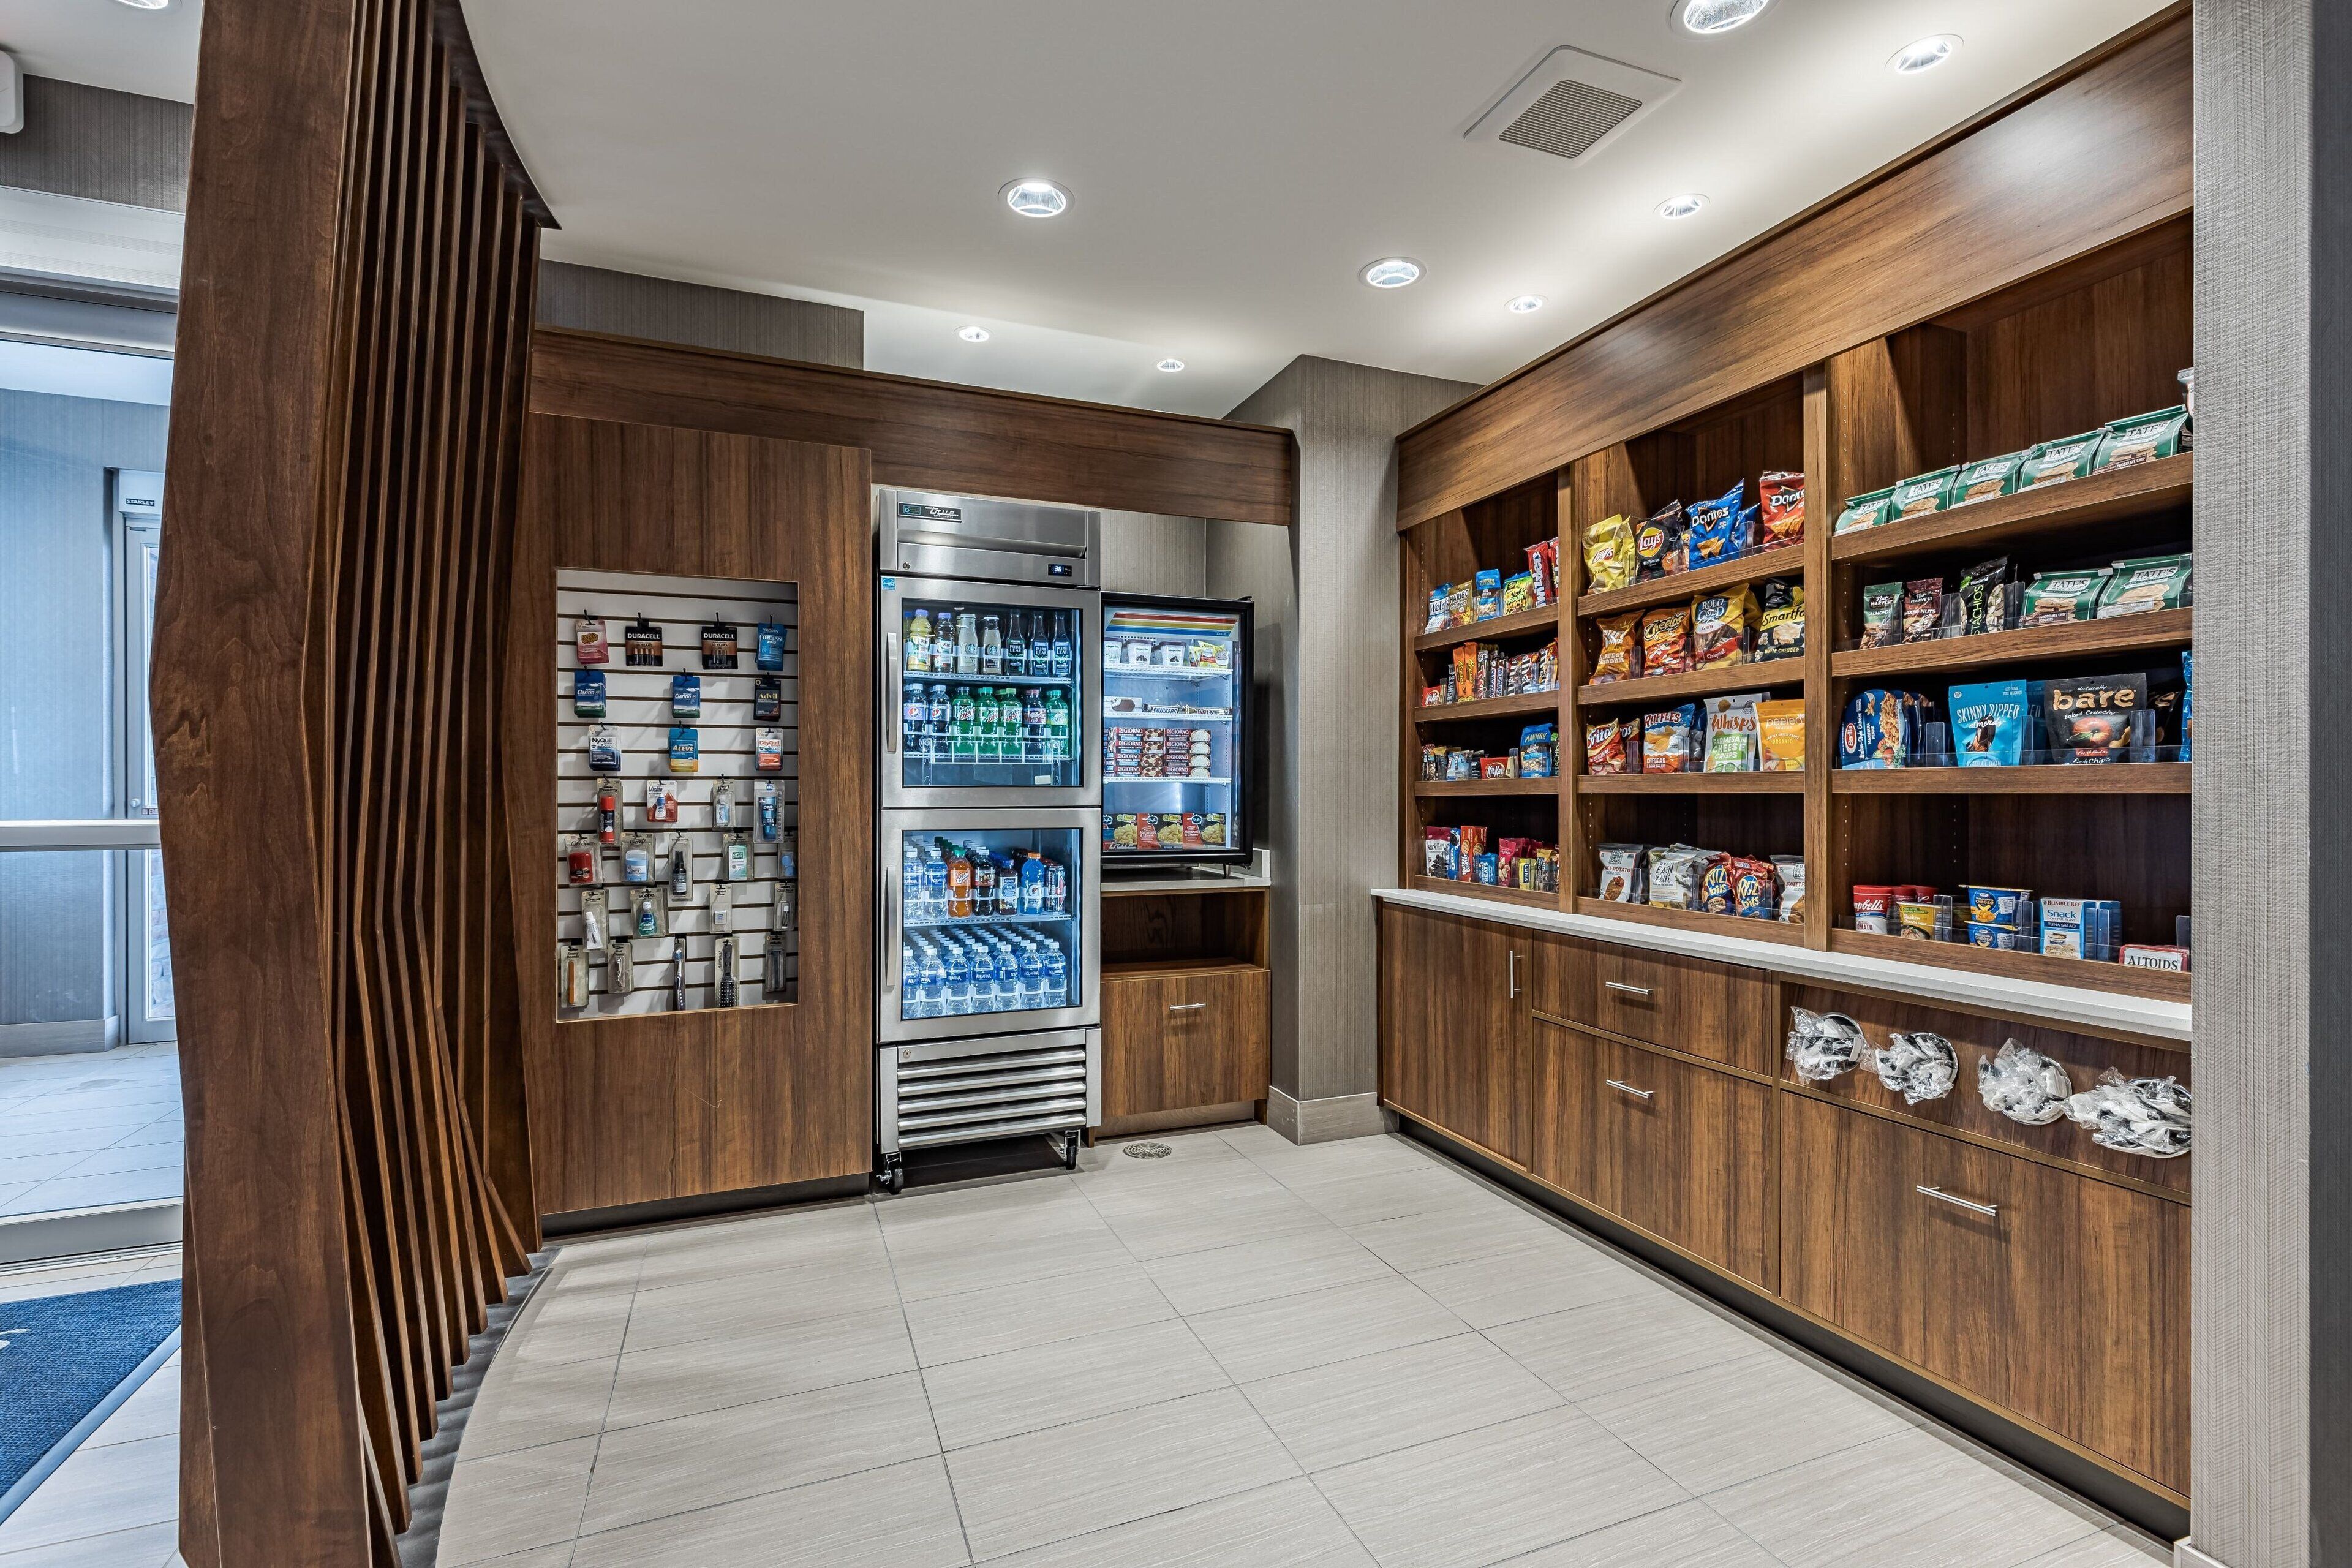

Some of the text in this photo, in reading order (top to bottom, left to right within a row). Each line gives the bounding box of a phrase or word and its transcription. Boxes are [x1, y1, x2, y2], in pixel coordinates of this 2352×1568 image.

[2128, 423, 2167, 436] TATE'S
[2048, 443, 2084, 457] TATE'S
[1977, 462, 2010, 473] TATE'S
[2116, 459, 2136, 468] CHOCOLATE
[1913, 480, 1942, 492] TATE'S
[1692, 507, 1729, 527] Doritos
[1639, 533, 1662, 551] Lay's
[2136, 568, 2176, 578] TATE'S
[2052, 579, 2089, 588] TATE'S
[1449, 589, 1469, 603] HARIBO
[1702, 599, 1724, 610] ROLD
[1698, 606, 1724, 620] GOLD
[1645, 612, 1686, 640] Cheetos
[1707, 648, 1725, 659] Original
[2053, 689, 2135, 710] bare
[1645, 712, 1681, 728] RUFFLES
[1957, 704, 1987, 723] SKINNY
[1988, 704, 2020, 719] DIPPED
[1710, 714, 1756, 731] Whisps
[1766, 715, 1803, 729] peeled
[1969, 717, 2004, 729] almonds
[1525, 733, 1547, 743] PLANTERS
[1588, 726, 1613, 749] Fritos
[1713, 743, 1745, 752] CHEESE
[1593, 748, 1610, 761] ORIGINAL
[957, 873, 968, 884] Crush
[1709, 884, 1727, 895] bits
[1738, 878, 1759, 898] RITZ
[1742, 897, 1759, 908] bits
[2047, 909, 2076, 919] Snack
[2128, 956, 2178, 970] ALTOIDS
